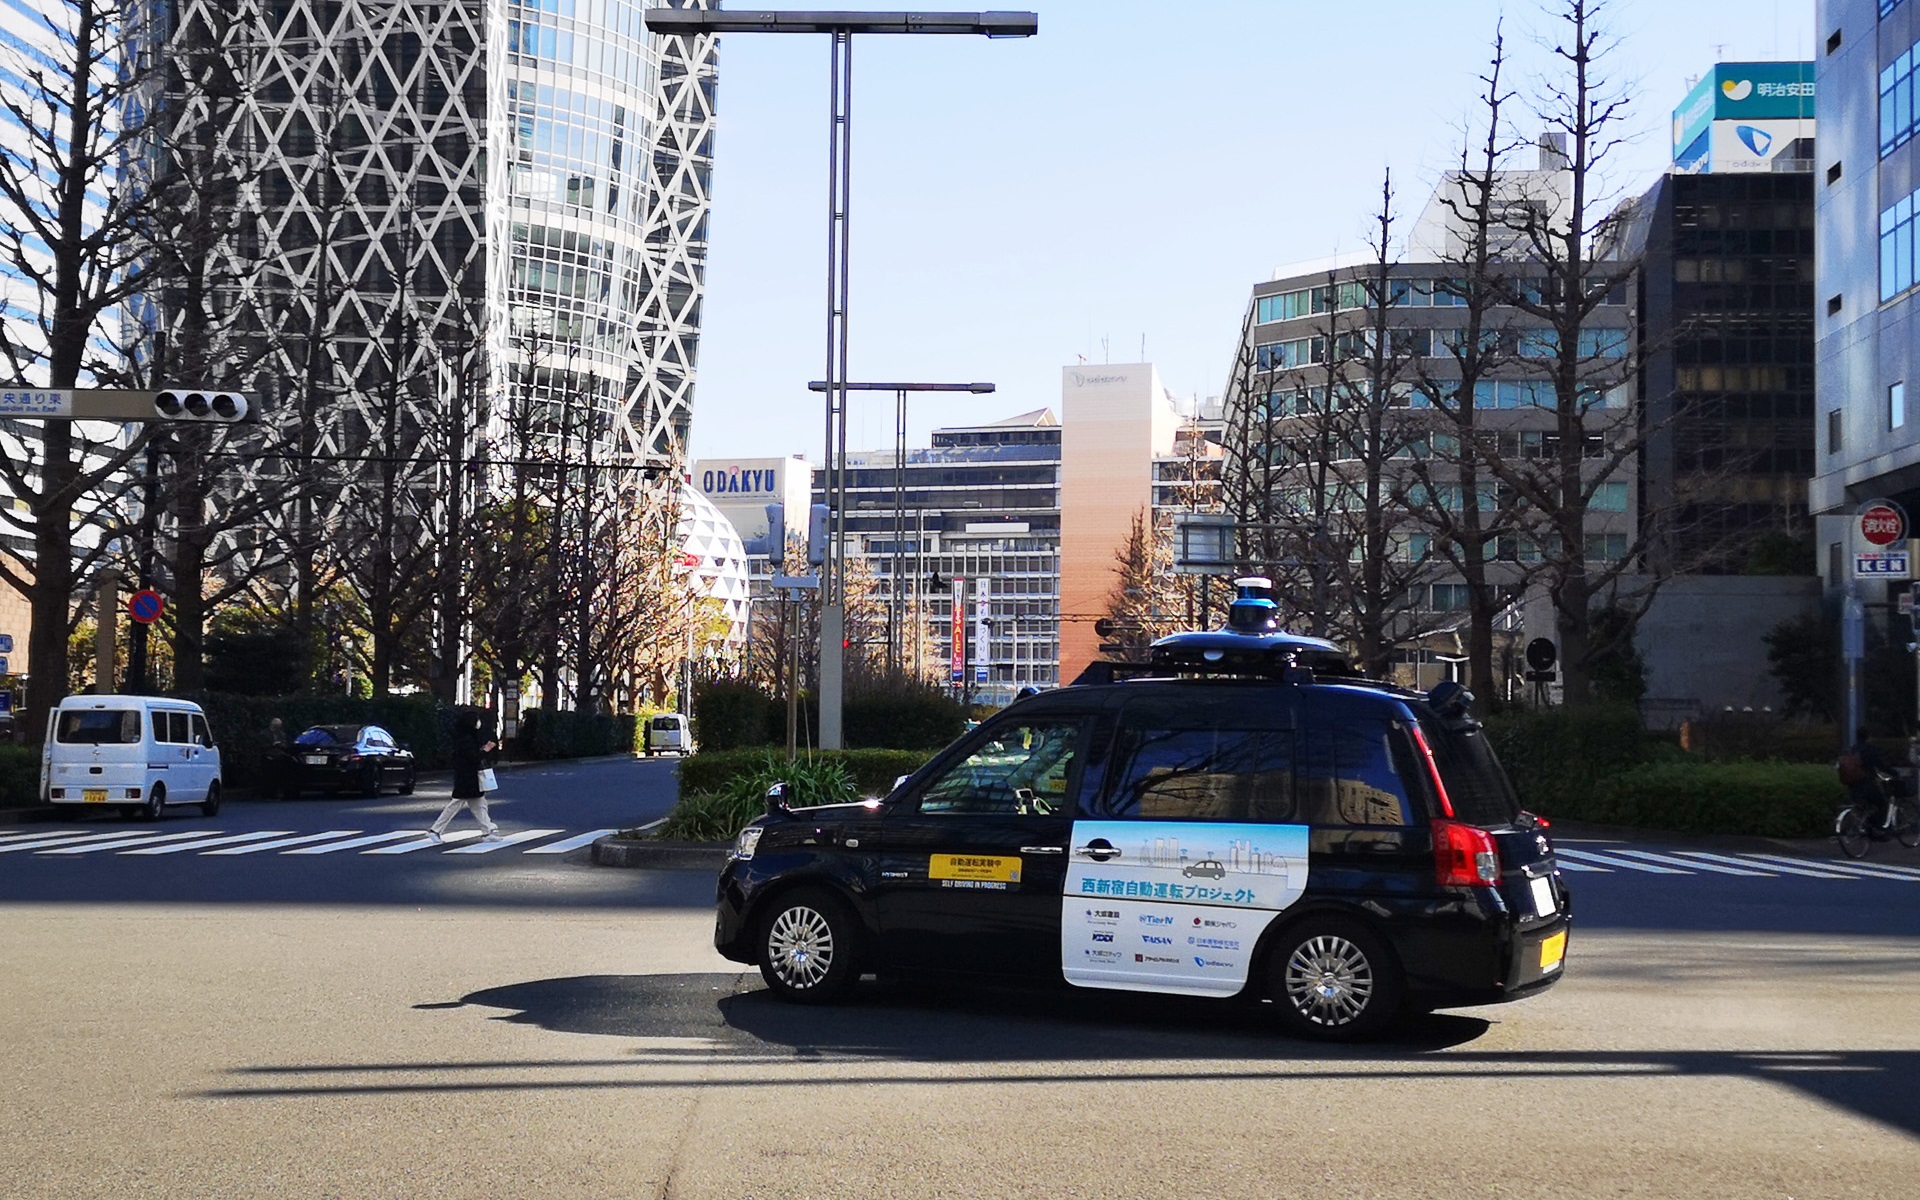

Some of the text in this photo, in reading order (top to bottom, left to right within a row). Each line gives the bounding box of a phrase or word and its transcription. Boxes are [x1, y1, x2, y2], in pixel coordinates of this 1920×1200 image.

[1757, 82, 1815, 97] 明治安田
[703, 467, 775, 493] ODAKYU
[1864, 518, 1898, 534] 消火栓
[1860, 560, 1902, 571] KEN
[941, 879, 954, 888] SELF
[1081, 877, 1256, 903] 西新宿自動運転プロジェクト
